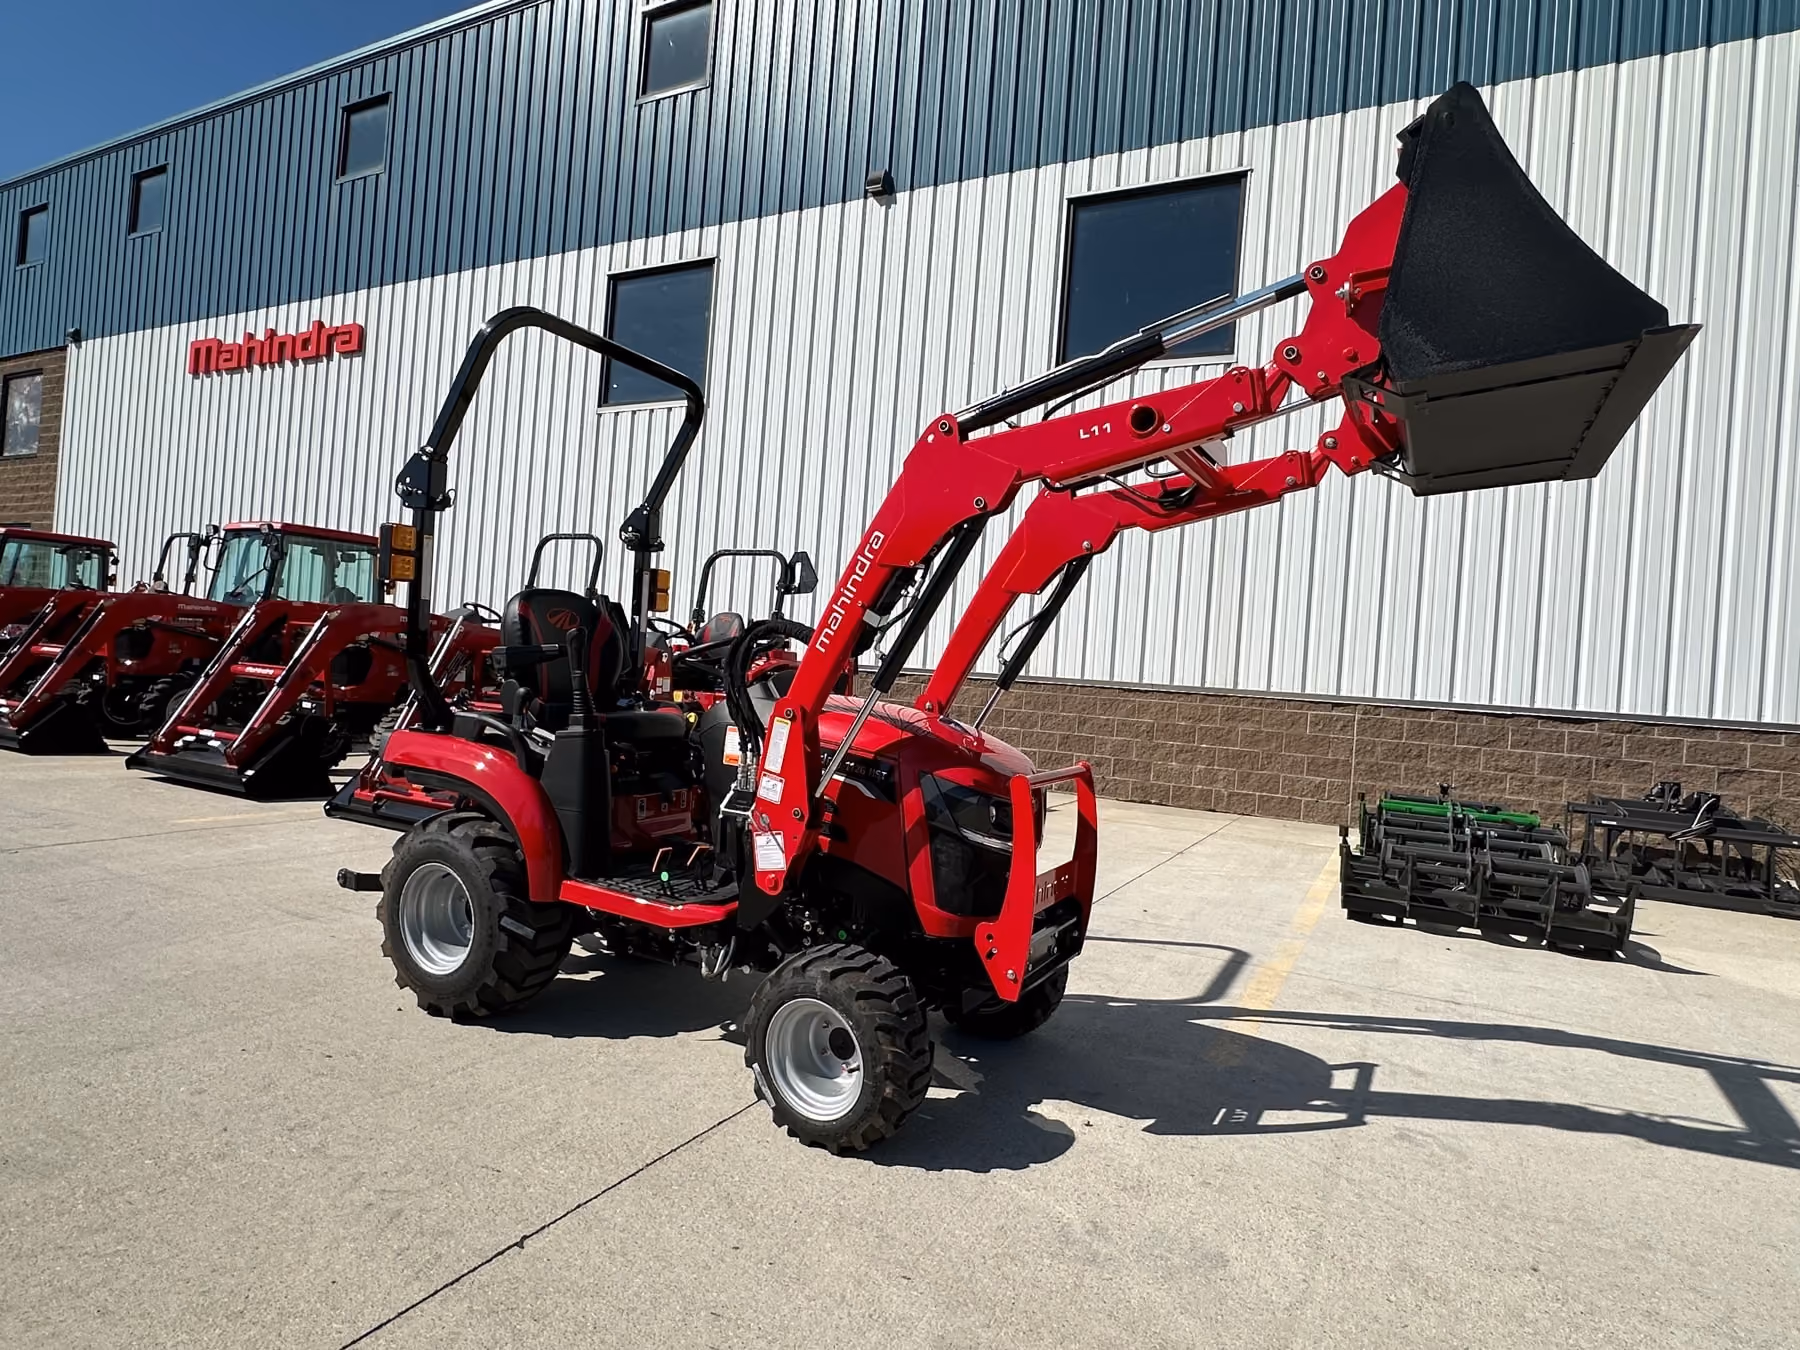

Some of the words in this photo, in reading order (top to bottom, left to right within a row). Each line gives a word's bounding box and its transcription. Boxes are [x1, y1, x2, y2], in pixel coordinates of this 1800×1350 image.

[188, 320, 364, 375] Mahindra
[1080, 422, 1111, 439] L11
[815, 530, 885, 653] mahindra
